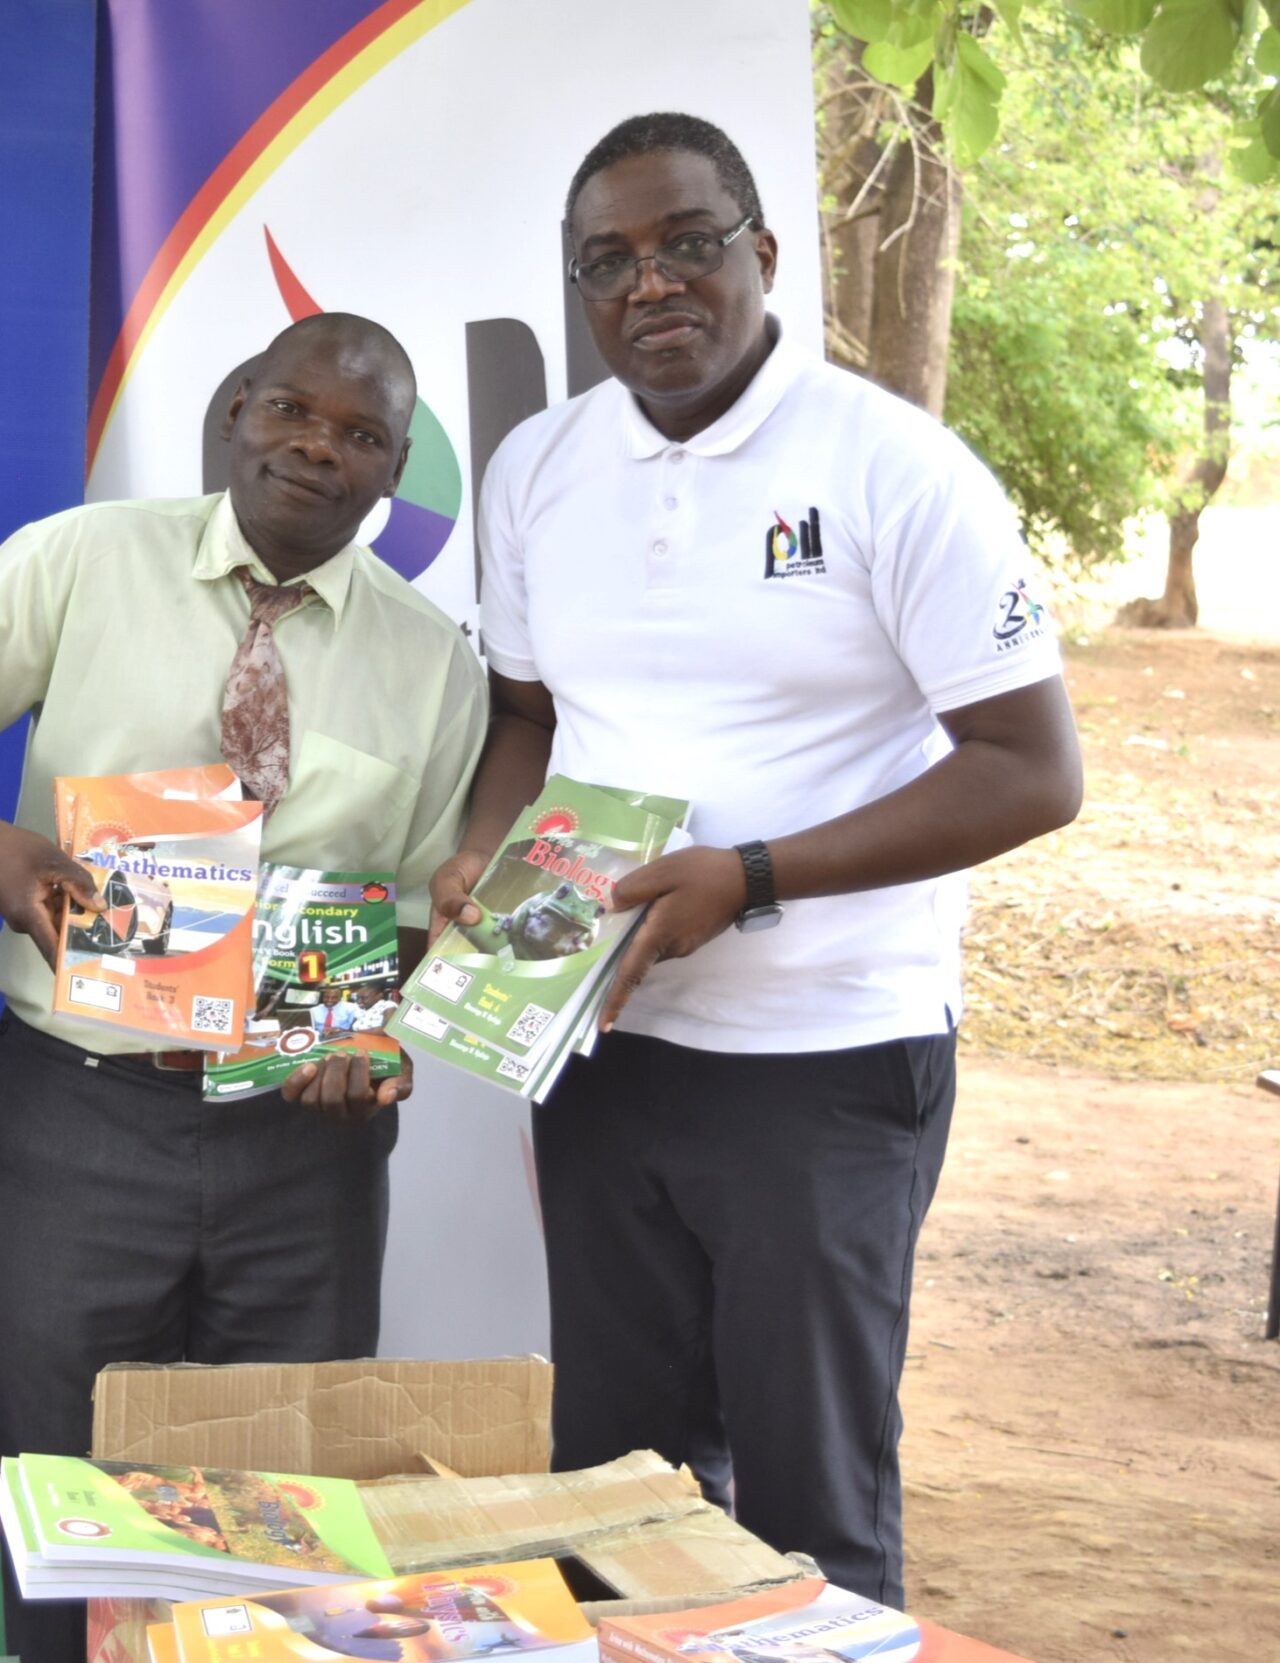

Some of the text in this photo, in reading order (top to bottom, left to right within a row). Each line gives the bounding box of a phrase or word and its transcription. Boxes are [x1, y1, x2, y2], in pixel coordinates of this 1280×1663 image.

[93, 850, 253, 882] Mathematics
[522, 837, 618, 905] Biolog
[310, 886, 347, 899] ucceed
[299, 905, 359, 918] condary
[252, 918, 368, 951] nglish
[273, 948, 296, 957] Book
[302, 954, 319, 980] 1
[421, 1581, 469, 1643] Physics
[704, 1604, 885, 1653] Mathematics
